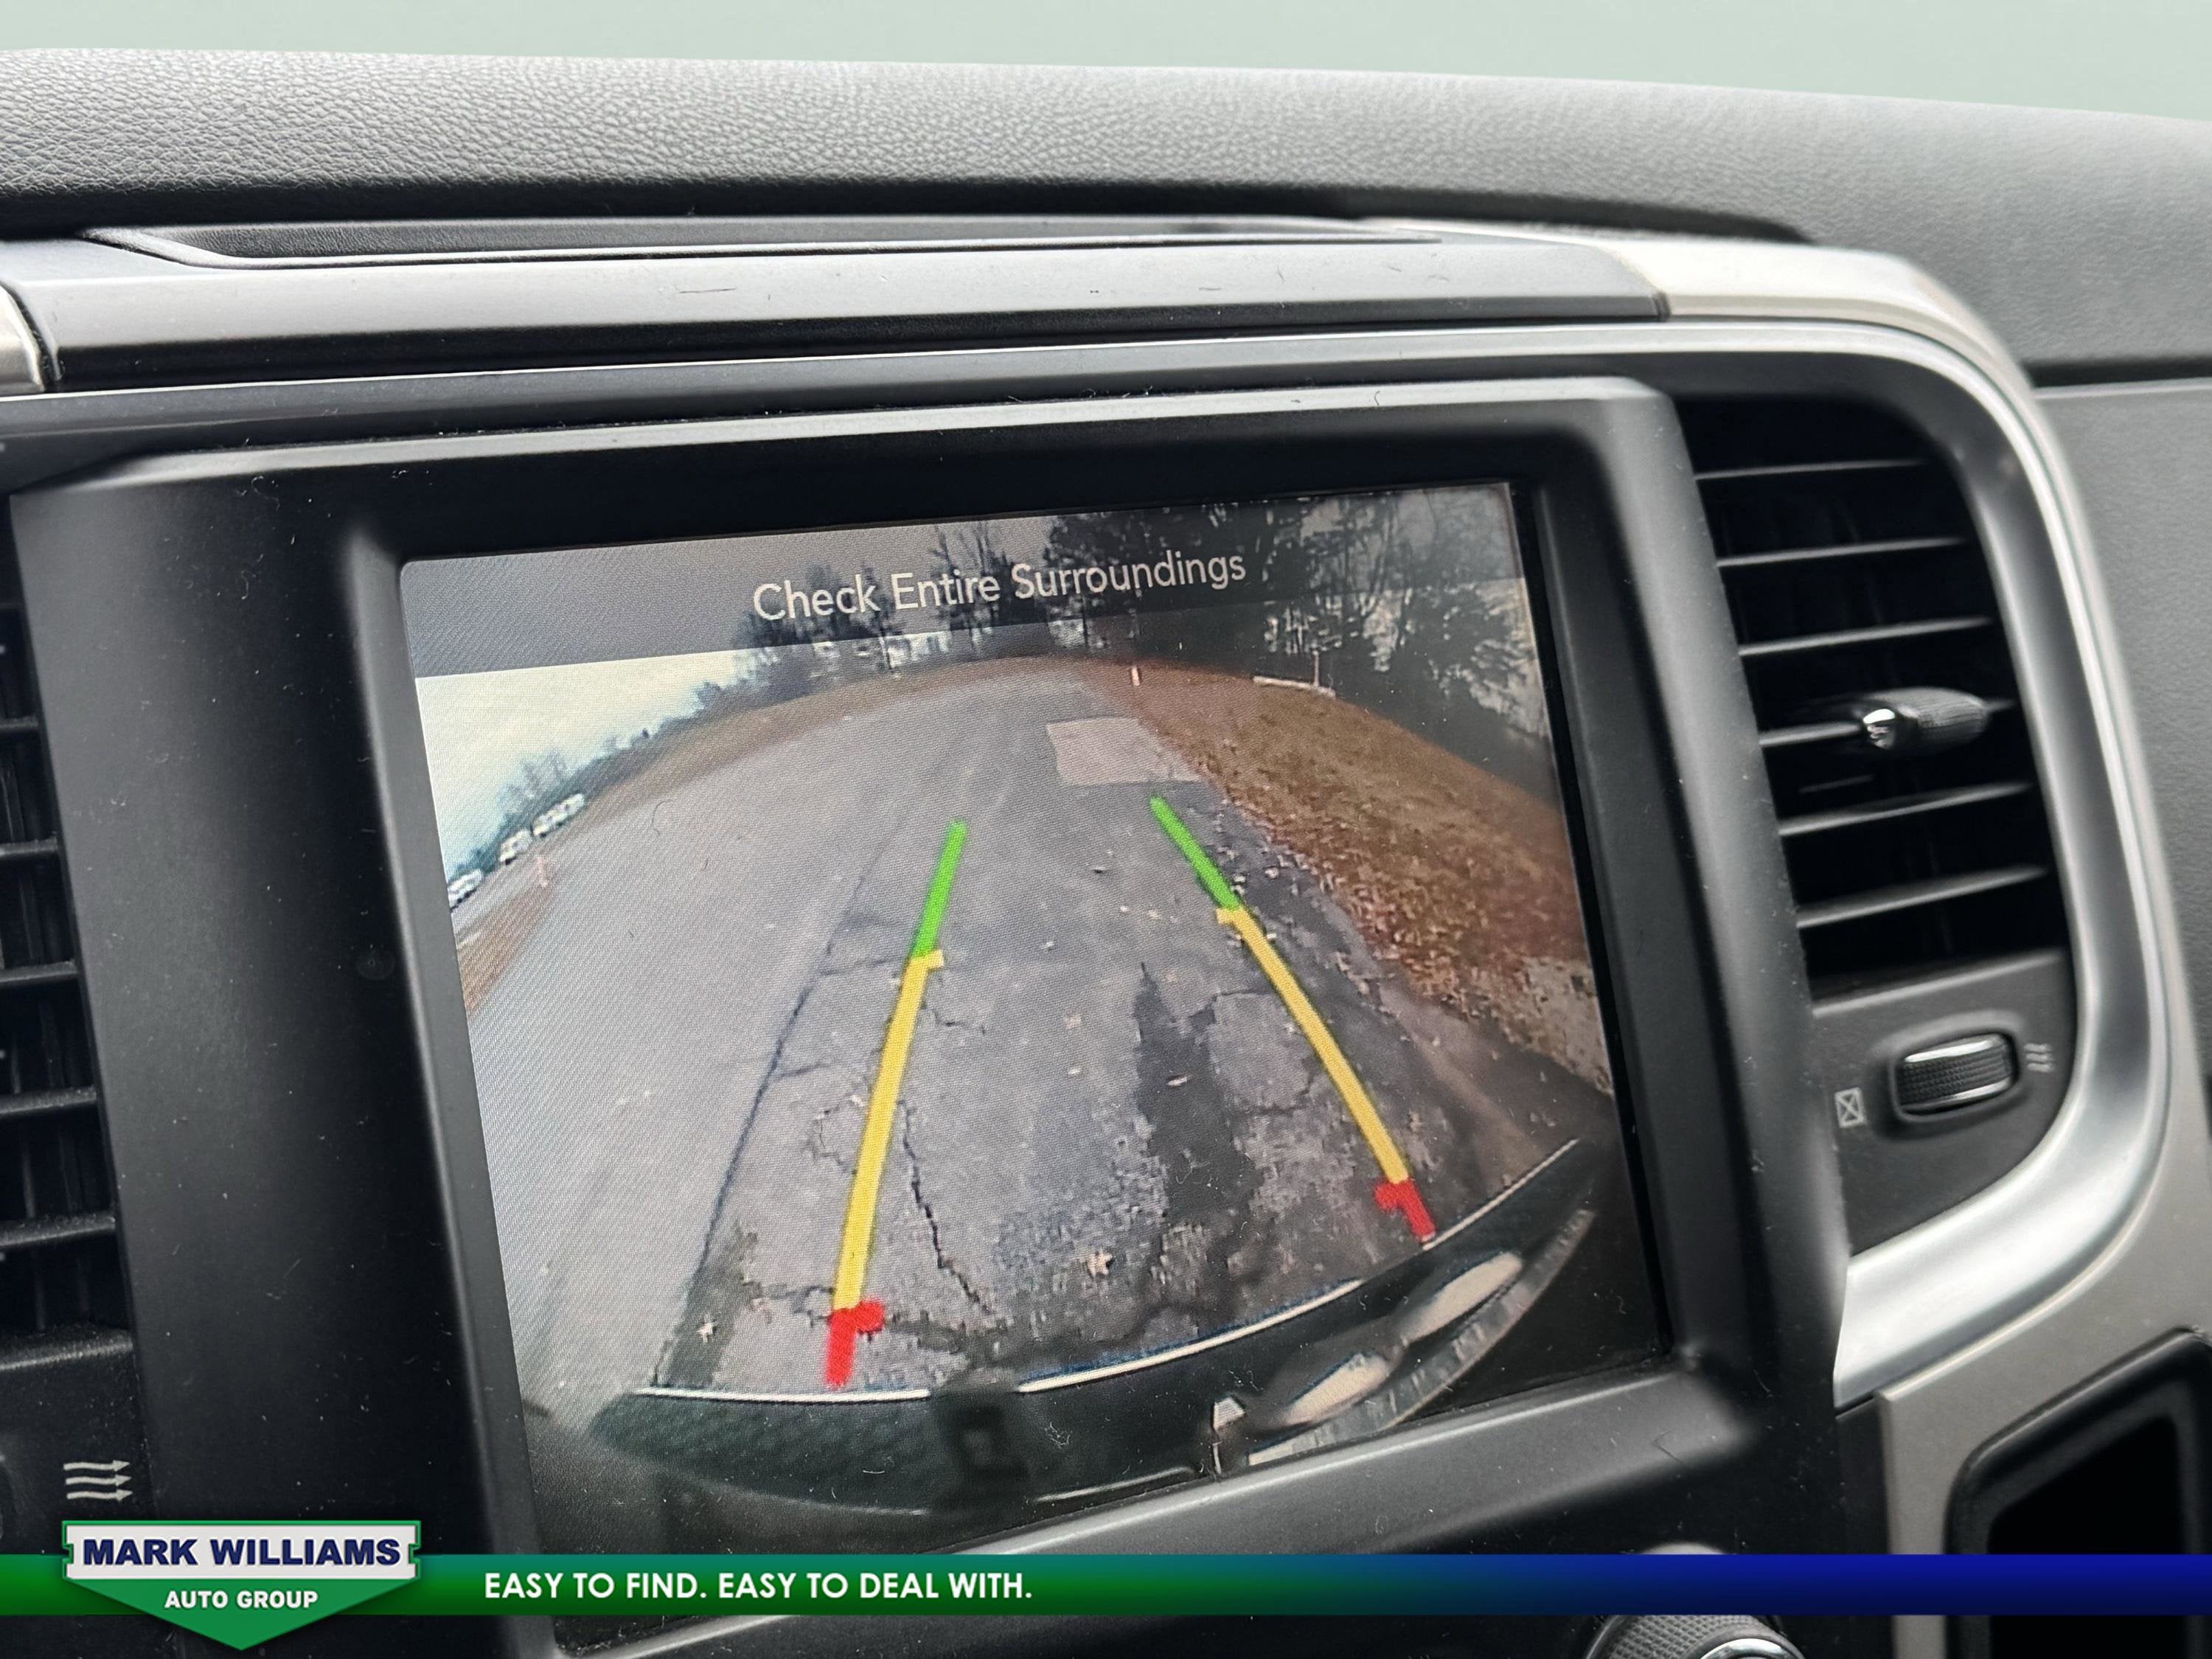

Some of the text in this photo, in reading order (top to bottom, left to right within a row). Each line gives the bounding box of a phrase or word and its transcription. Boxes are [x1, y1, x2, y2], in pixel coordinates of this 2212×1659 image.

[753, 549, 1247, 621] Check Entire Surroundings
